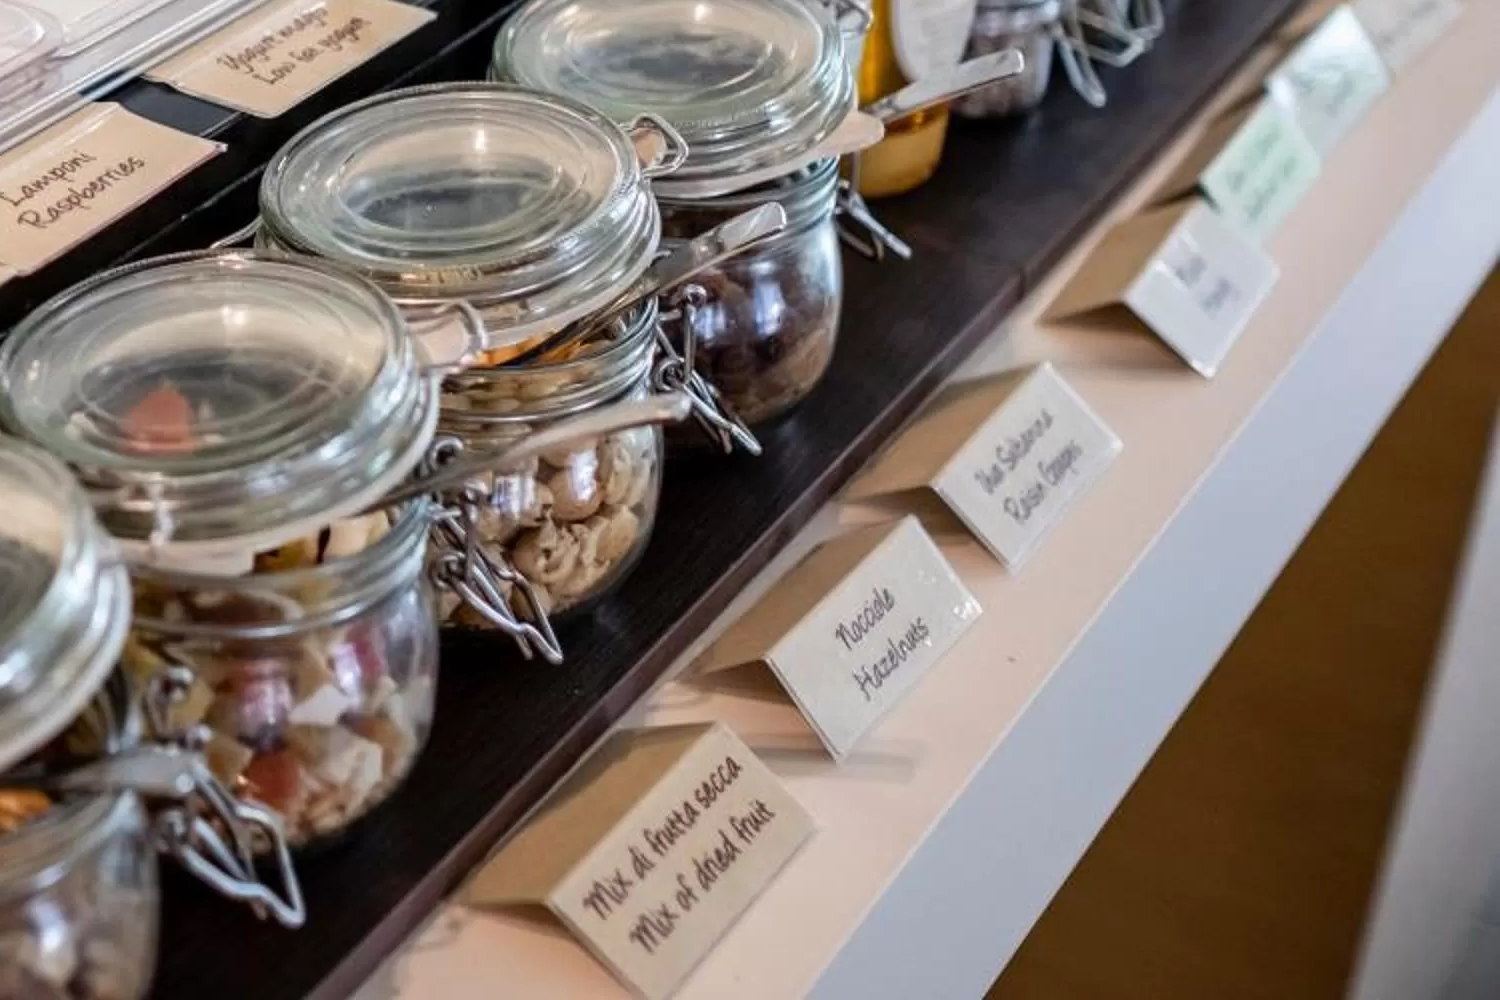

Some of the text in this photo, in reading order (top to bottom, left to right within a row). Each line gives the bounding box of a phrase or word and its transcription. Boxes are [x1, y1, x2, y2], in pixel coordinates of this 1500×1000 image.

[18, 154, 146, 229] Raspberries
[852, 616, 930, 702] Hazelnuts
[582, 755, 743, 921] Mix di frutta secca
[628, 799, 777, 953] Mix of dried fruit
